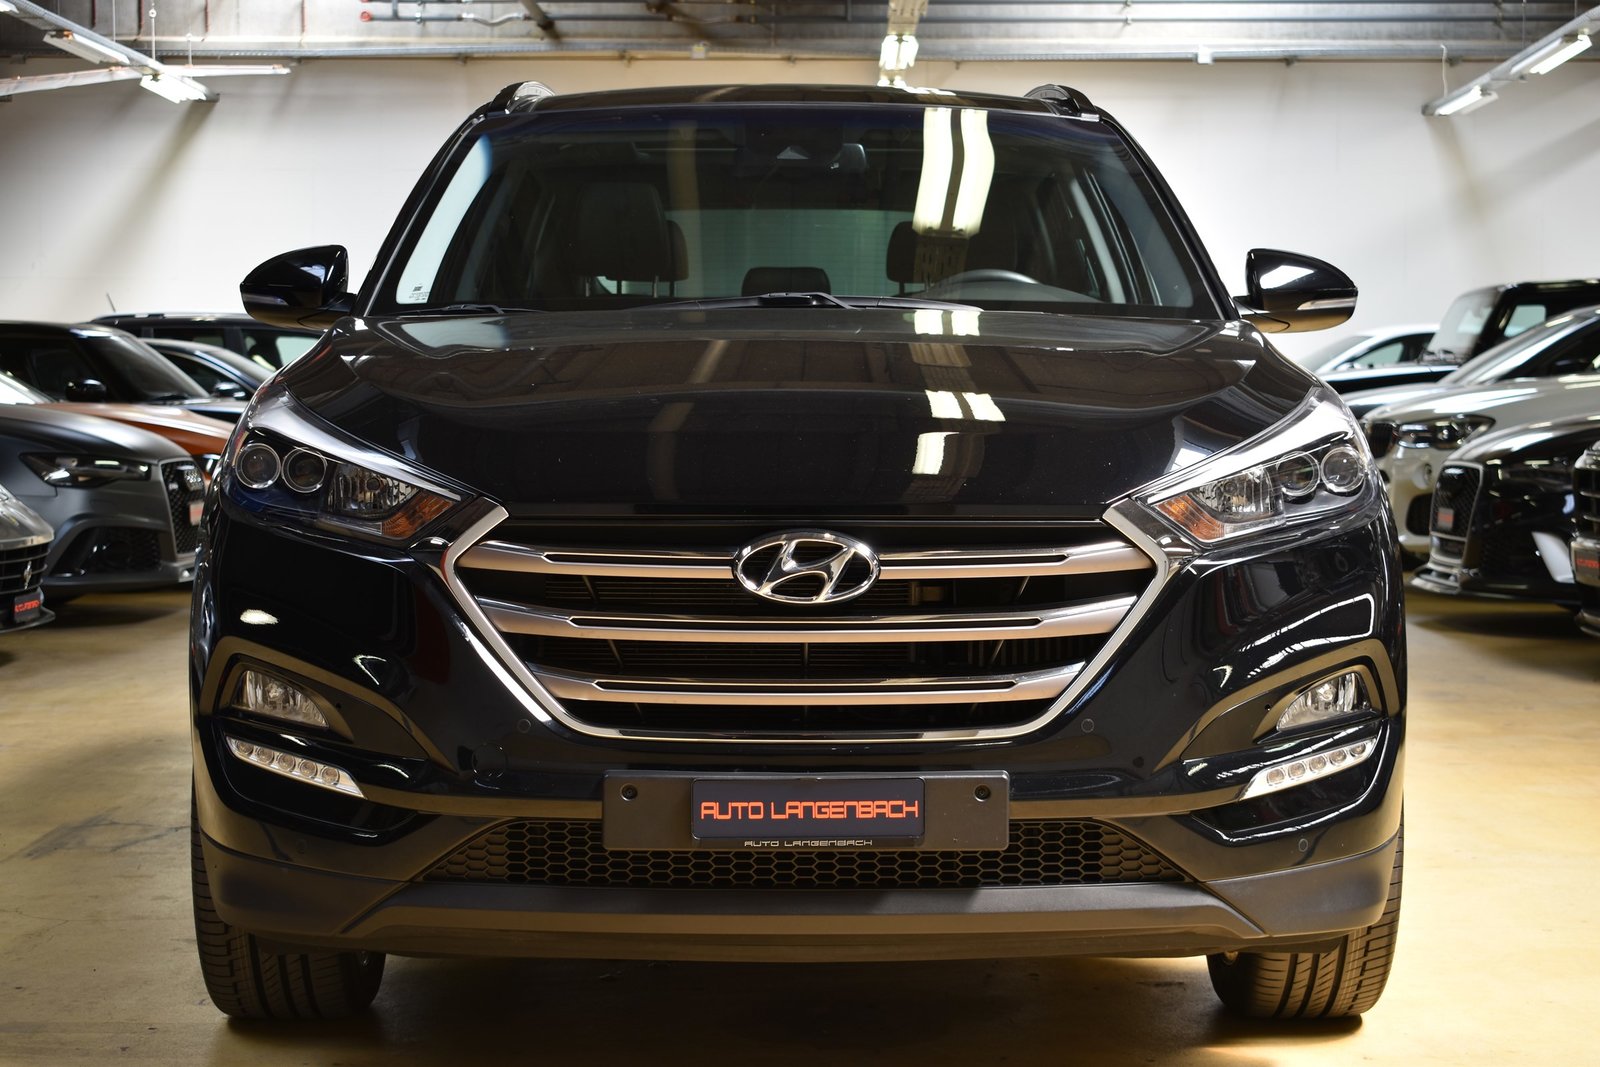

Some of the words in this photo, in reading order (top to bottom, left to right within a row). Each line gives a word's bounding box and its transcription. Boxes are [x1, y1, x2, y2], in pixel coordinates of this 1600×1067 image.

[701, 801, 764, 820] AUTO
[771, 800, 918, 820] LANGENBACH
[744, 839, 779, 847] AUTO
[784, 839, 873, 847] LANGENBACH
